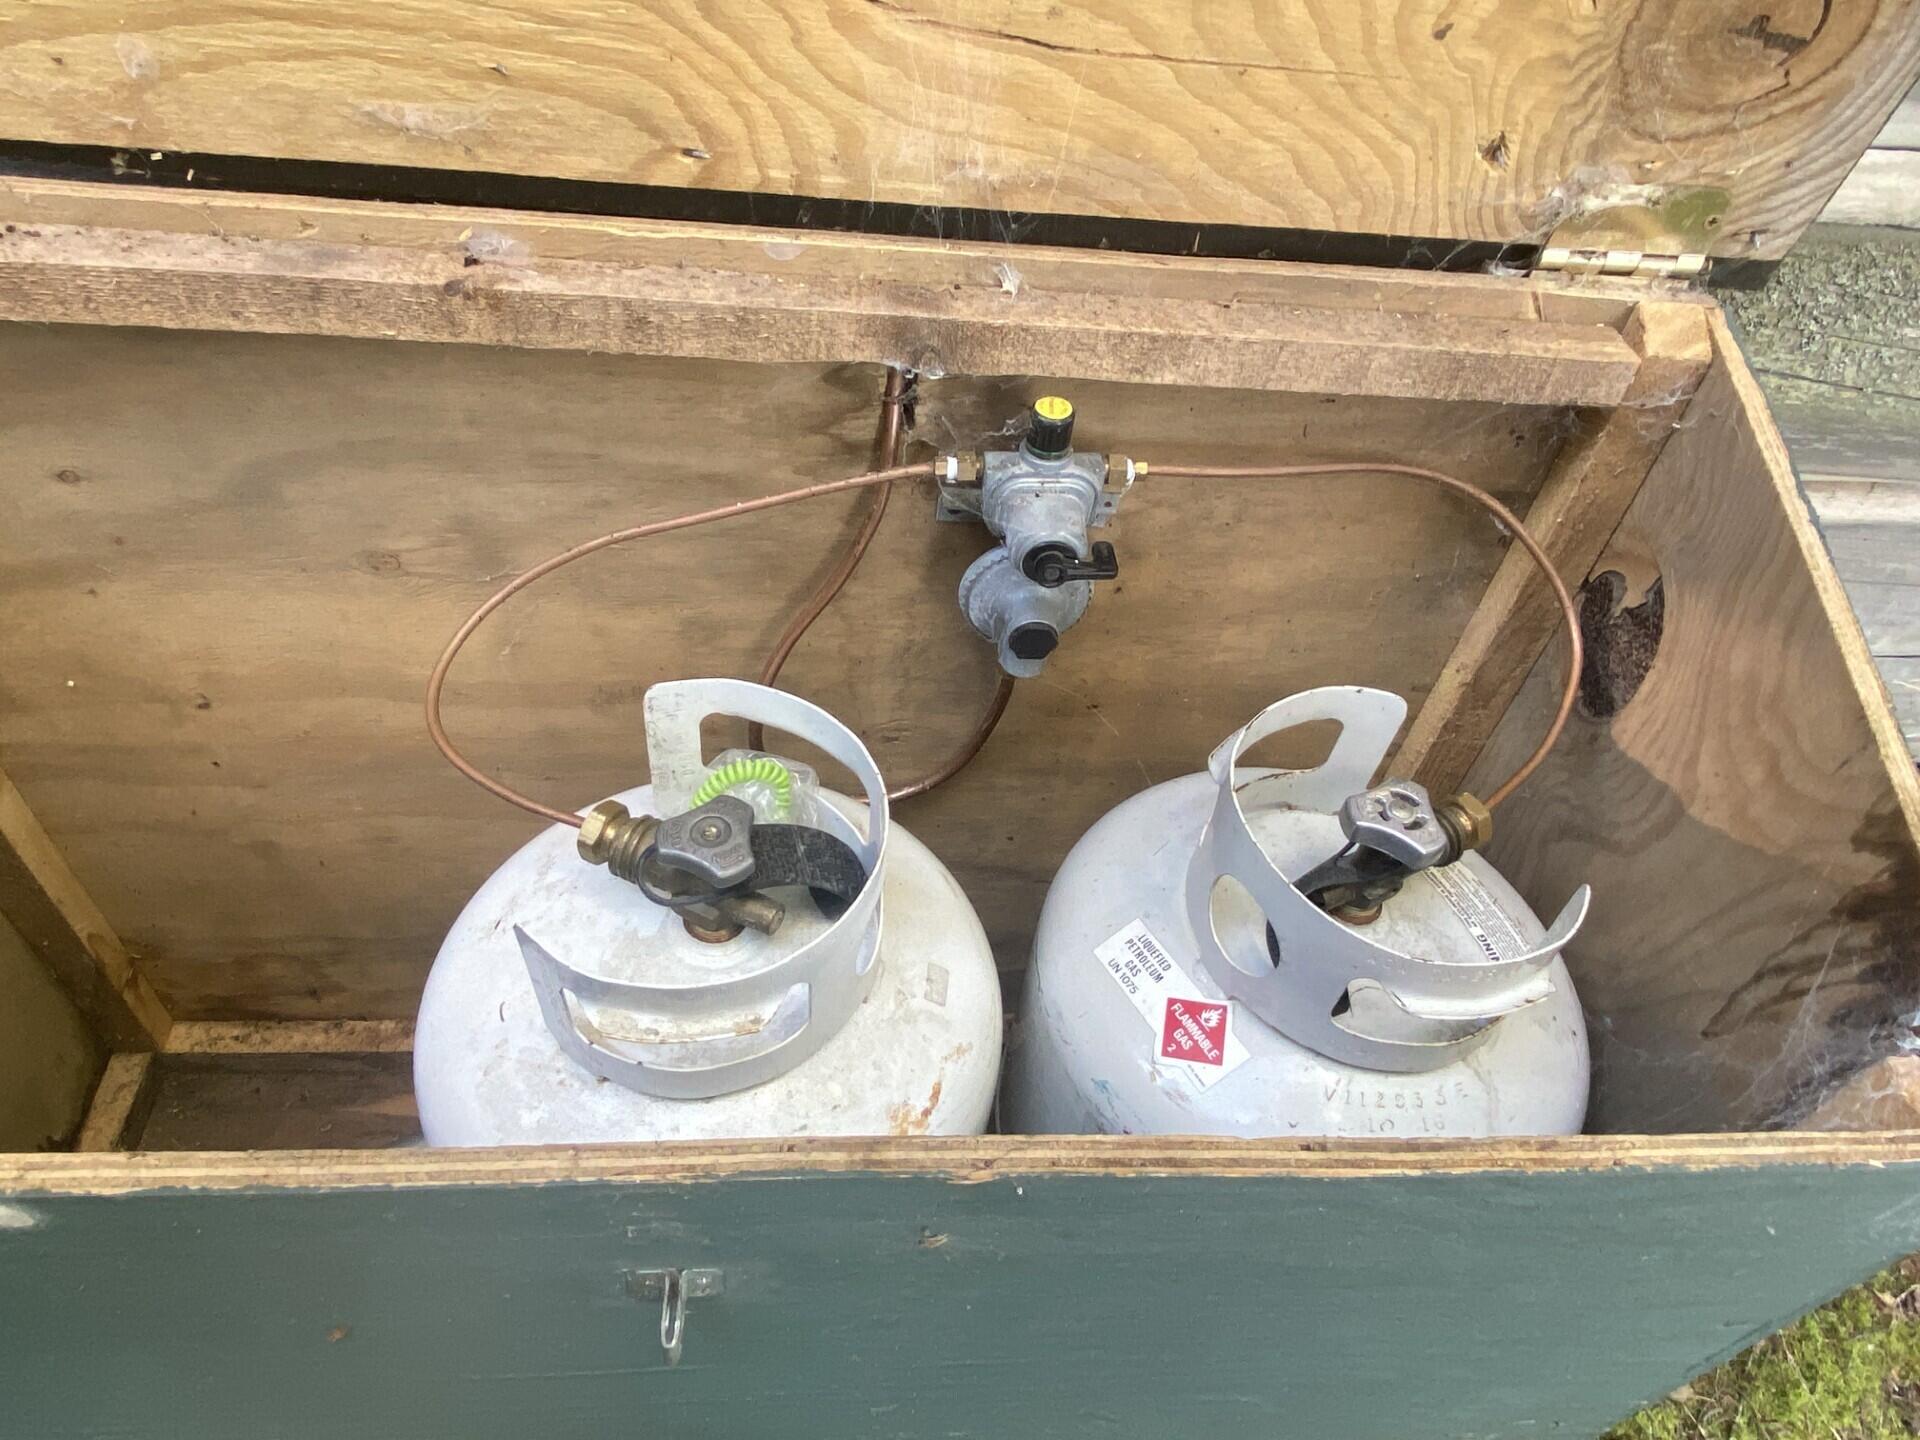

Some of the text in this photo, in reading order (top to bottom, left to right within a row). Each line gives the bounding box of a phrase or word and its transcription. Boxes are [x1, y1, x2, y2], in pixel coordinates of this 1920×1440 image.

[1124, 938, 1165, 984] PETROLEUM
[1124, 959, 1142, 978] GAS
[1137, 934, 1172, 972] LIQUEFIED
[1107, 958, 1139, 995] UN 1075
[1166, 1043, 1176, 1053] 2
[1170, 1002, 1220, 1061] FLAMMABLE
[1173, 1028, 1194, 1051] GAS
